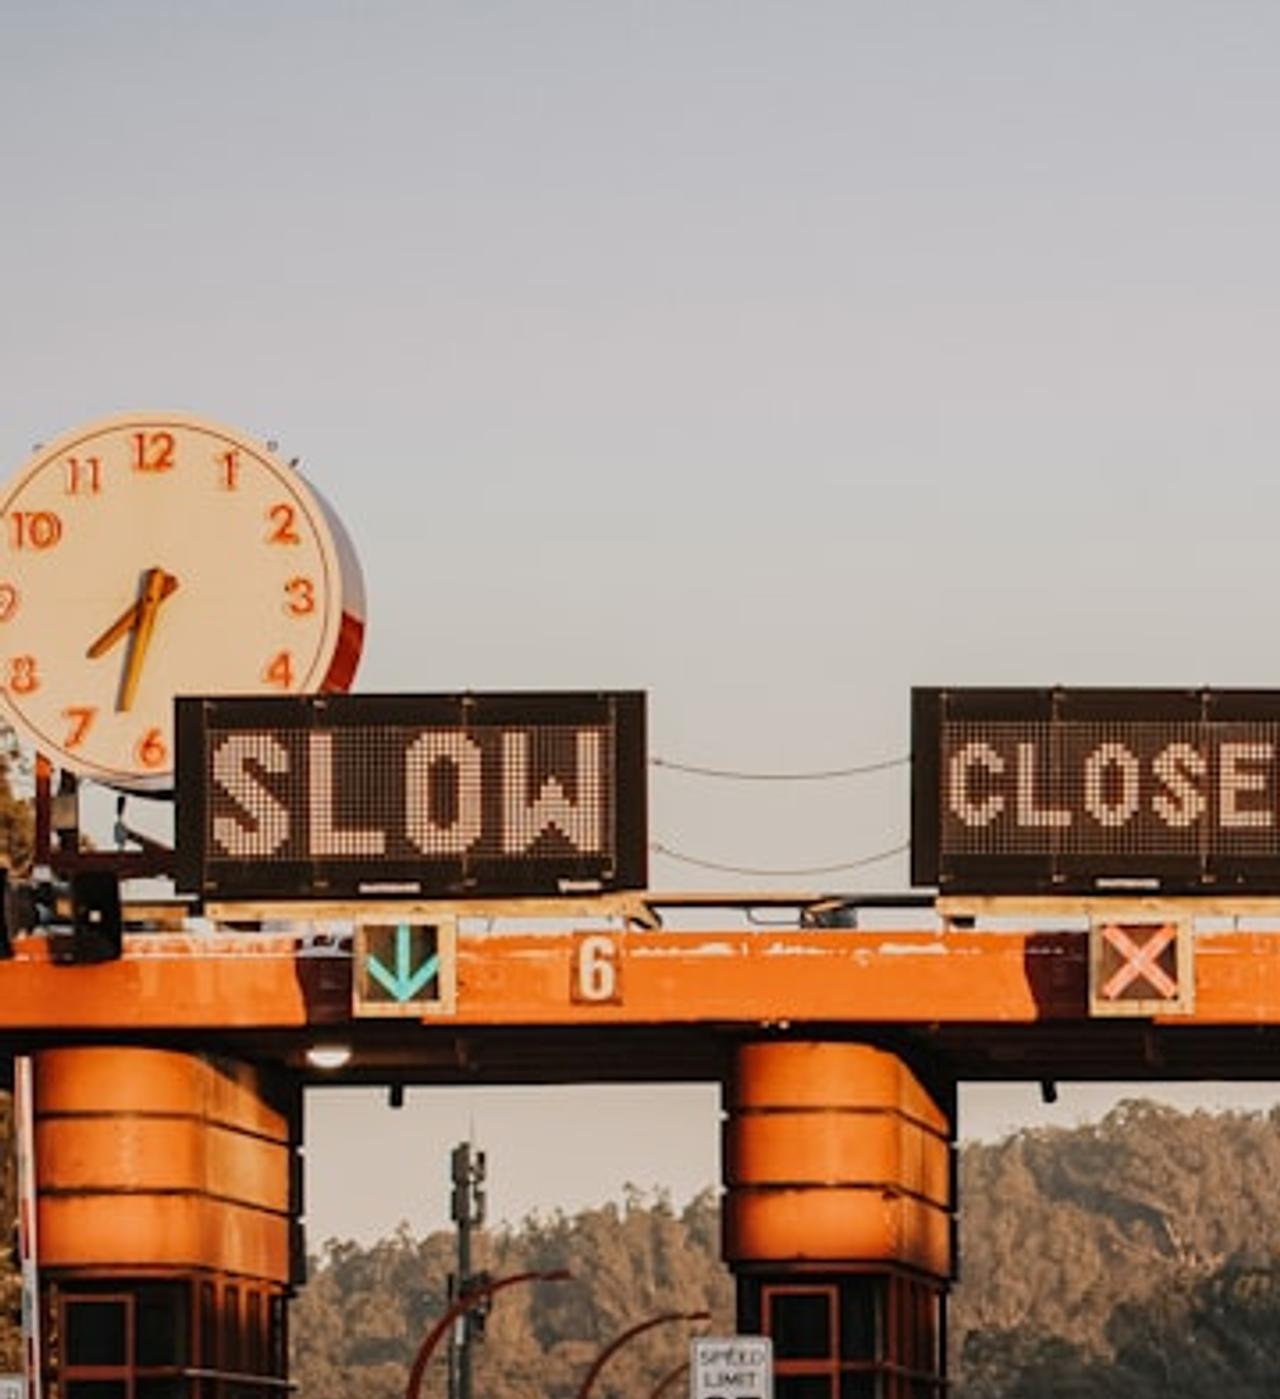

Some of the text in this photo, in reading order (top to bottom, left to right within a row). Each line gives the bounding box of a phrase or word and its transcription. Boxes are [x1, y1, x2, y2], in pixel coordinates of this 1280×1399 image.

[133, 433, 174, 470] 12
[67, 458, 100, 494] 11
[220, 453, 238, 491] 1
[12, 511, 62, 548] 10
[268, 505, 298, 544] 2
[286, 578, 314, 615] 3
[11, 655, 38, 693] 8
[265, 652, 294, 688] 4
[62, 707, 96, 748] 7
[140, 729, 164, 763] 6
[213, 731, 601, 857] SLOW
[580, 936, 613, 1000] 6
[701, 1349, 764, 1367] SPEED
[704, 1372, 756, 1388] LIMIT
